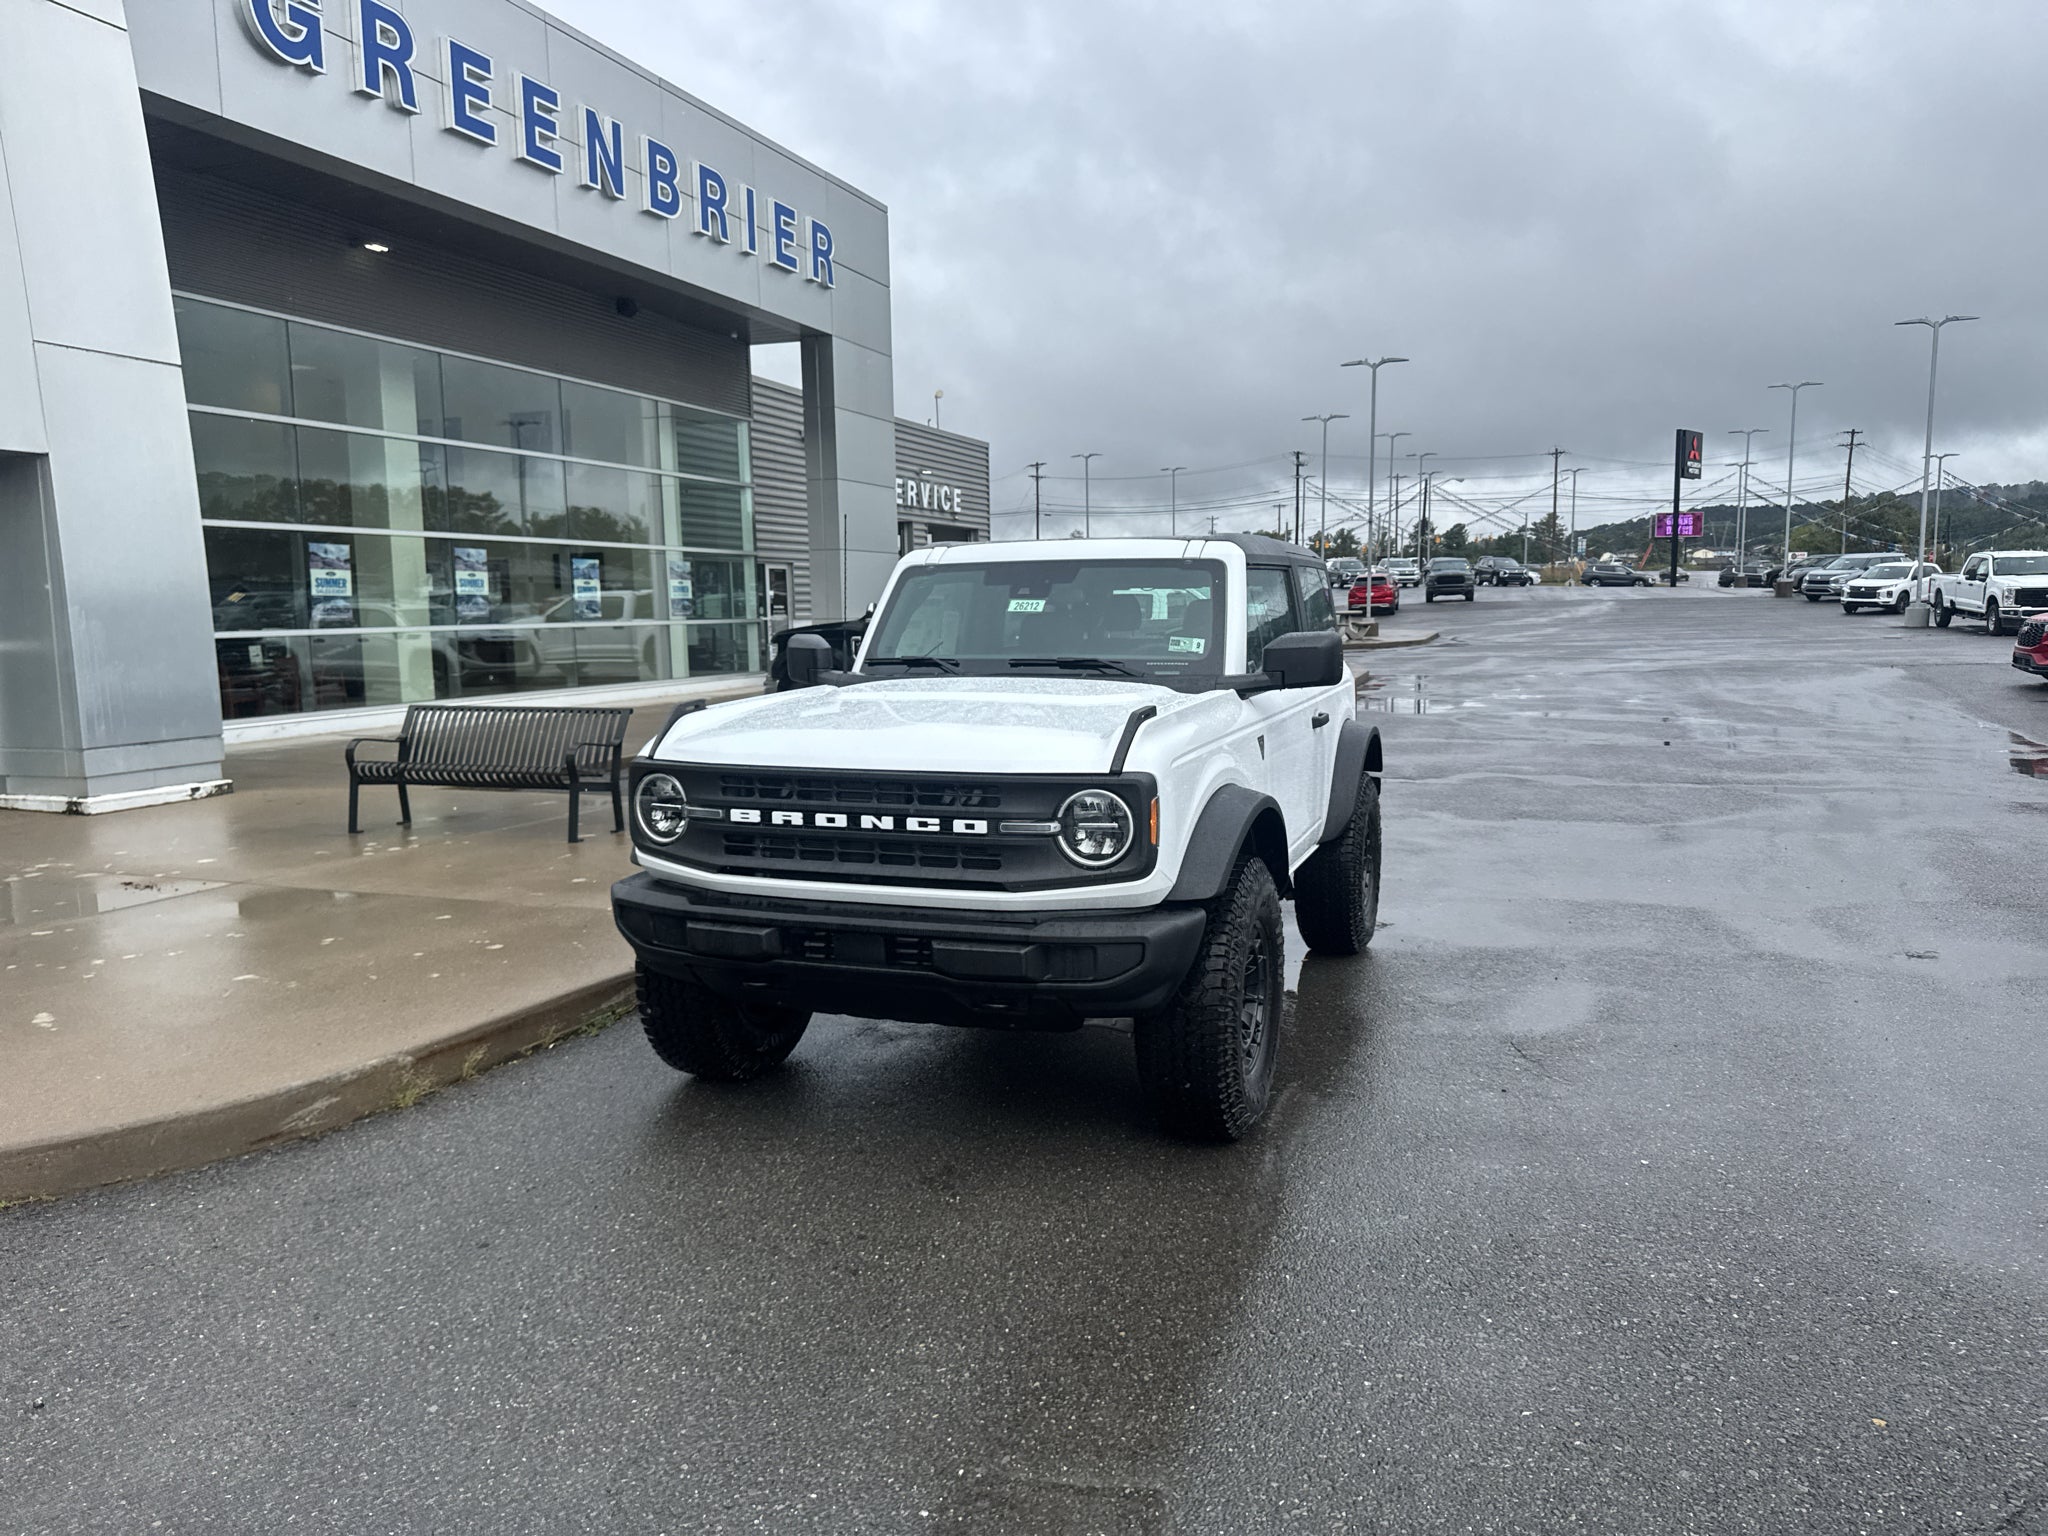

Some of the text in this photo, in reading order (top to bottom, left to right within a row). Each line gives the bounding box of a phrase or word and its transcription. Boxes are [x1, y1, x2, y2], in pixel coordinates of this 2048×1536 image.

[243, 0, 836, 288] GREENBRIER
[1013, 601, 1040, 611] 26212
[730, 808, 988, 834] BRONCO
